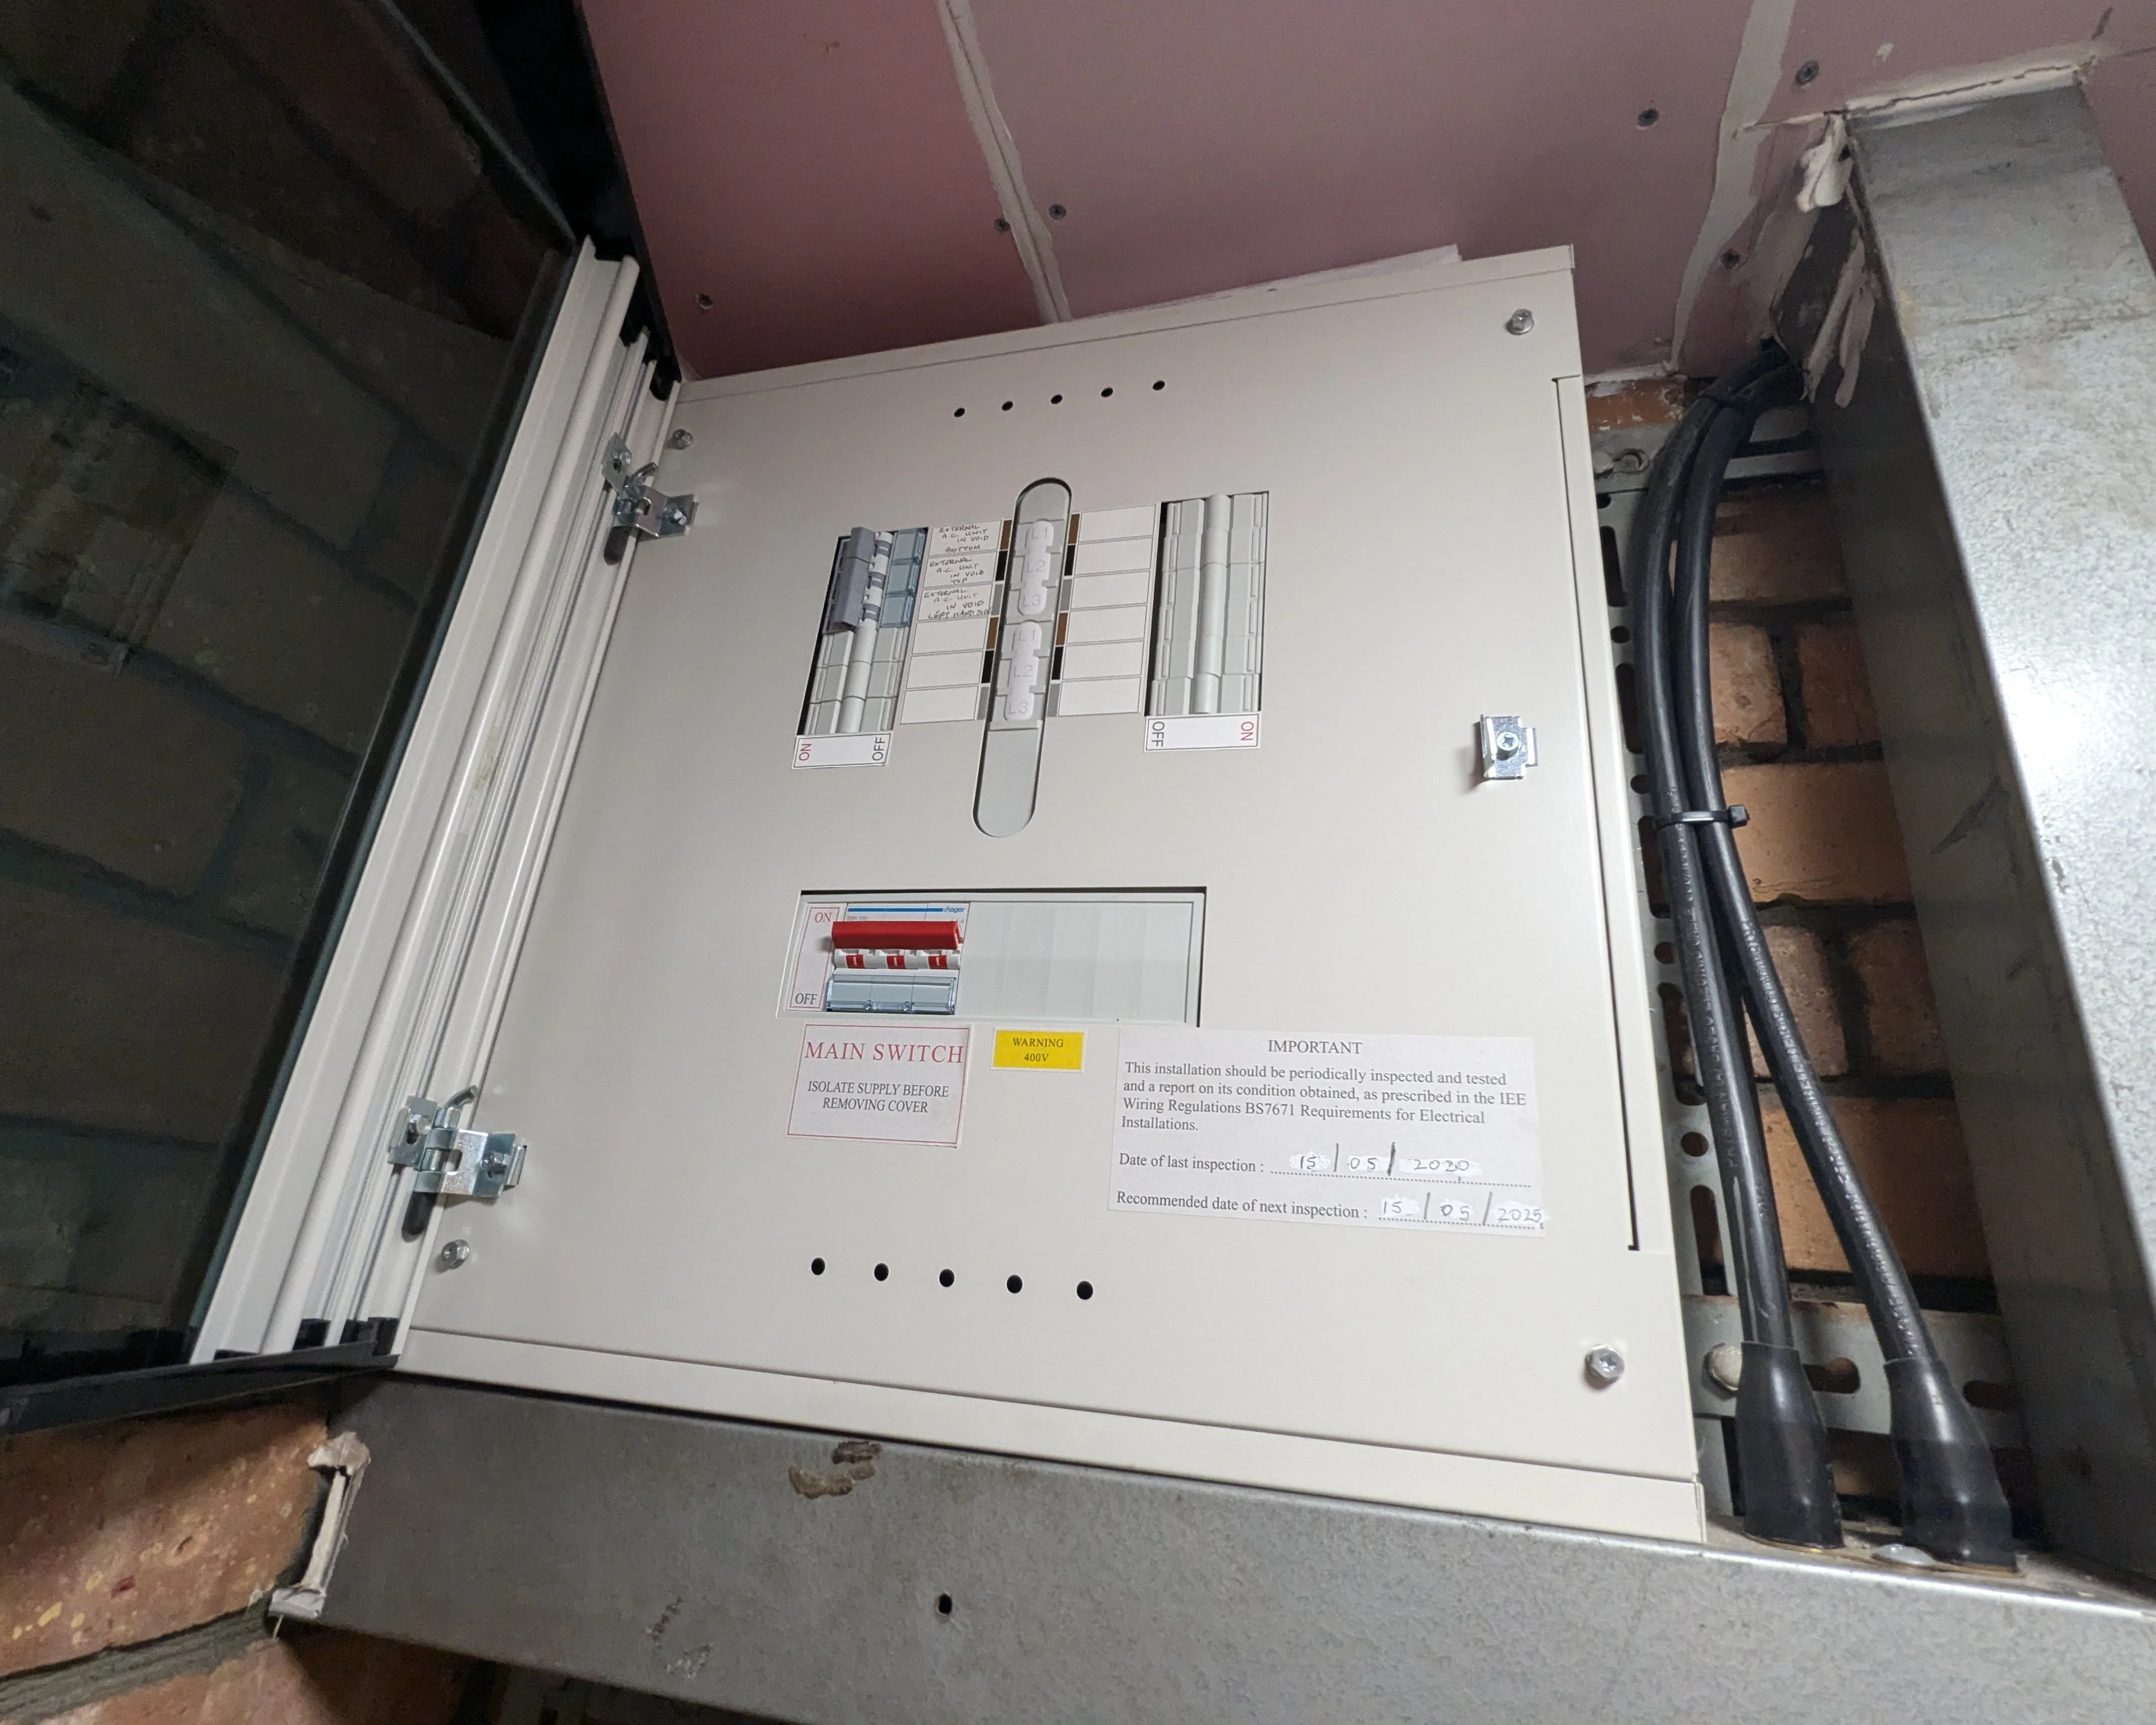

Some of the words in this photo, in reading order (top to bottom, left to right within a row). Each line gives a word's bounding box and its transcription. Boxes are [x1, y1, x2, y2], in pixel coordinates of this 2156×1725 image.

[1031, 527, 1048, 539] L1
[1026, 560, 1045, 573] L2
[1022, 595, 1041, 606] L3
[1018, 628, 1036, 641] L1
[1013, 665, 1033, 677] L2
[1011, 702, 1029, 714] L3
[1152, 721, 1165, 747] OFF
[1241, 721, 1254, 741] ON
[799, 743, 812, 761] ON
[872, 737, 885, 761] OFF
[815, 912, 832, 923] ON
[795, 993, 817, 1005] OFF
[1013, 1038, 1063, 1048] WARNING
[1268, 1039, 1363, 1054] IMPORTANT
[805, 1042, 865, 1060] MAIN
[873, 1043, 964, 1063] SWITCH
[1024, 1053, 1049, 1062] 400V
[1125, 1062, 1151, 1074] This
[1155, 1062, 1221, 1076] installation
[1226, 1065, 1267, 1078] should
[1271, 1066, 1286, 1078] be
[1290, 1067, 1366, 1083] periodically
[1371, 1069, 1433, 1084] inspected
[1437, 1071, 1462, 1084] and
[1466, 1073, 1507, 1085] tested
[807, 1081, 855, 1093] ISOLATE
[857, 1083, 901, 1095] SUPPLY
[903, 1084, 949, 1097] BEFORE
[1123, 1080, 1145, 1092] and
[1149, 1084, 1155, 1092] a
[1159, 1083, 1195, 1096] report
[1199, 1085, 1214, 1094] on
[1218, 1083, 1232, 1095] its
[1236, 1084, 1296, 1097] condition
[1300, 1086, 1359, 1102] obtained,
[1364, 1091, 1378, 1100] as
[1381, 1089, 1452, 1103] prescribed
[1456, 1091, 1470, 1103] in
[1474, 1092, 1495, 1105] the
[1500, 1092, 1526, 1105] IEE
[823, 1098, 885, 1111] REMOVING
[888, 1100, 928, 1113] COVER
[1123, 1097, 1164, 1114] Wiring
[1168, 1099, 1241, 1115] Regulations
[1245, 1102, 1294, 1116] BS7671
[1300, 1104, 1392, 1120] Requirements
[1396, 1108, 1415, 1121] for
[1420, 1109, 1485, 1124] Electrical
[1122, 1116, 1199, 1130] Installations.
[1119, 1153, 1147, 1166] Date
[1151, 1154, 1166, 1167] of
[1167, 1156, 1189, 1169] last
[1193, 1156, 1256, 1172] inspection
[1300, 1156, 1318, 1170] 15
[1350, 1157, 1378, 1171] 05
[1117, 1191, 1208, 1208] Recommended
[1212, 1197, 1238, 1210] date
[1243, 1199, 1258, 1212] of
[1259, 1203, 1287, 1213] next
[1291, 1201, 1359, 1219] inspection
[1383, 1201, 1401, 1214] 15
[1441, 1204, 1470, 1221] 05
[1497, 1208, 1542, 1223] 2025
